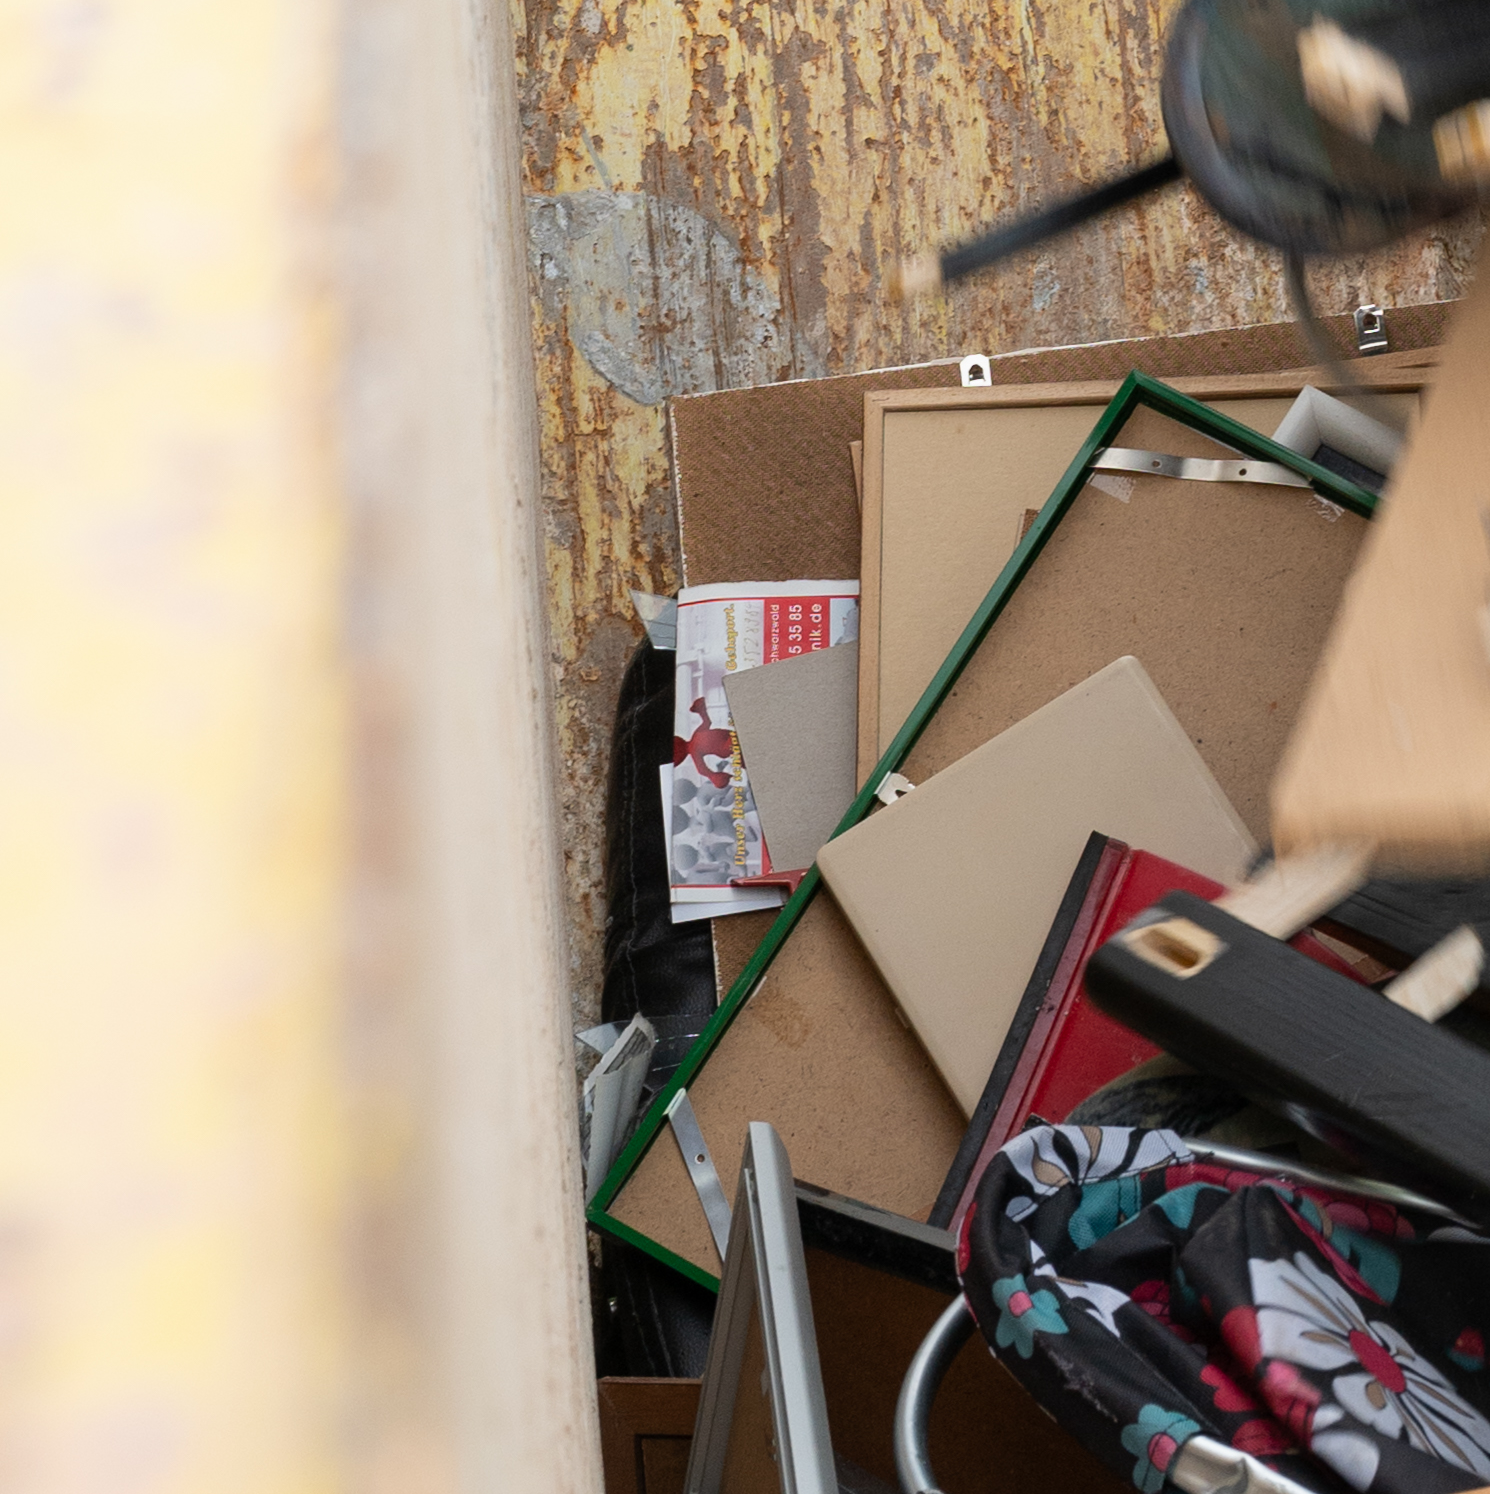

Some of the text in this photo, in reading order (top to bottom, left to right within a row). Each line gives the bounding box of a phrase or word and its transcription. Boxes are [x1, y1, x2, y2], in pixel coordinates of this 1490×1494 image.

[787, 604, 803, 622] 85
[787, 624, 803, 642] 35
[731, 786, 745, 820] Herz
[734, 823, 746, 866] Unser
